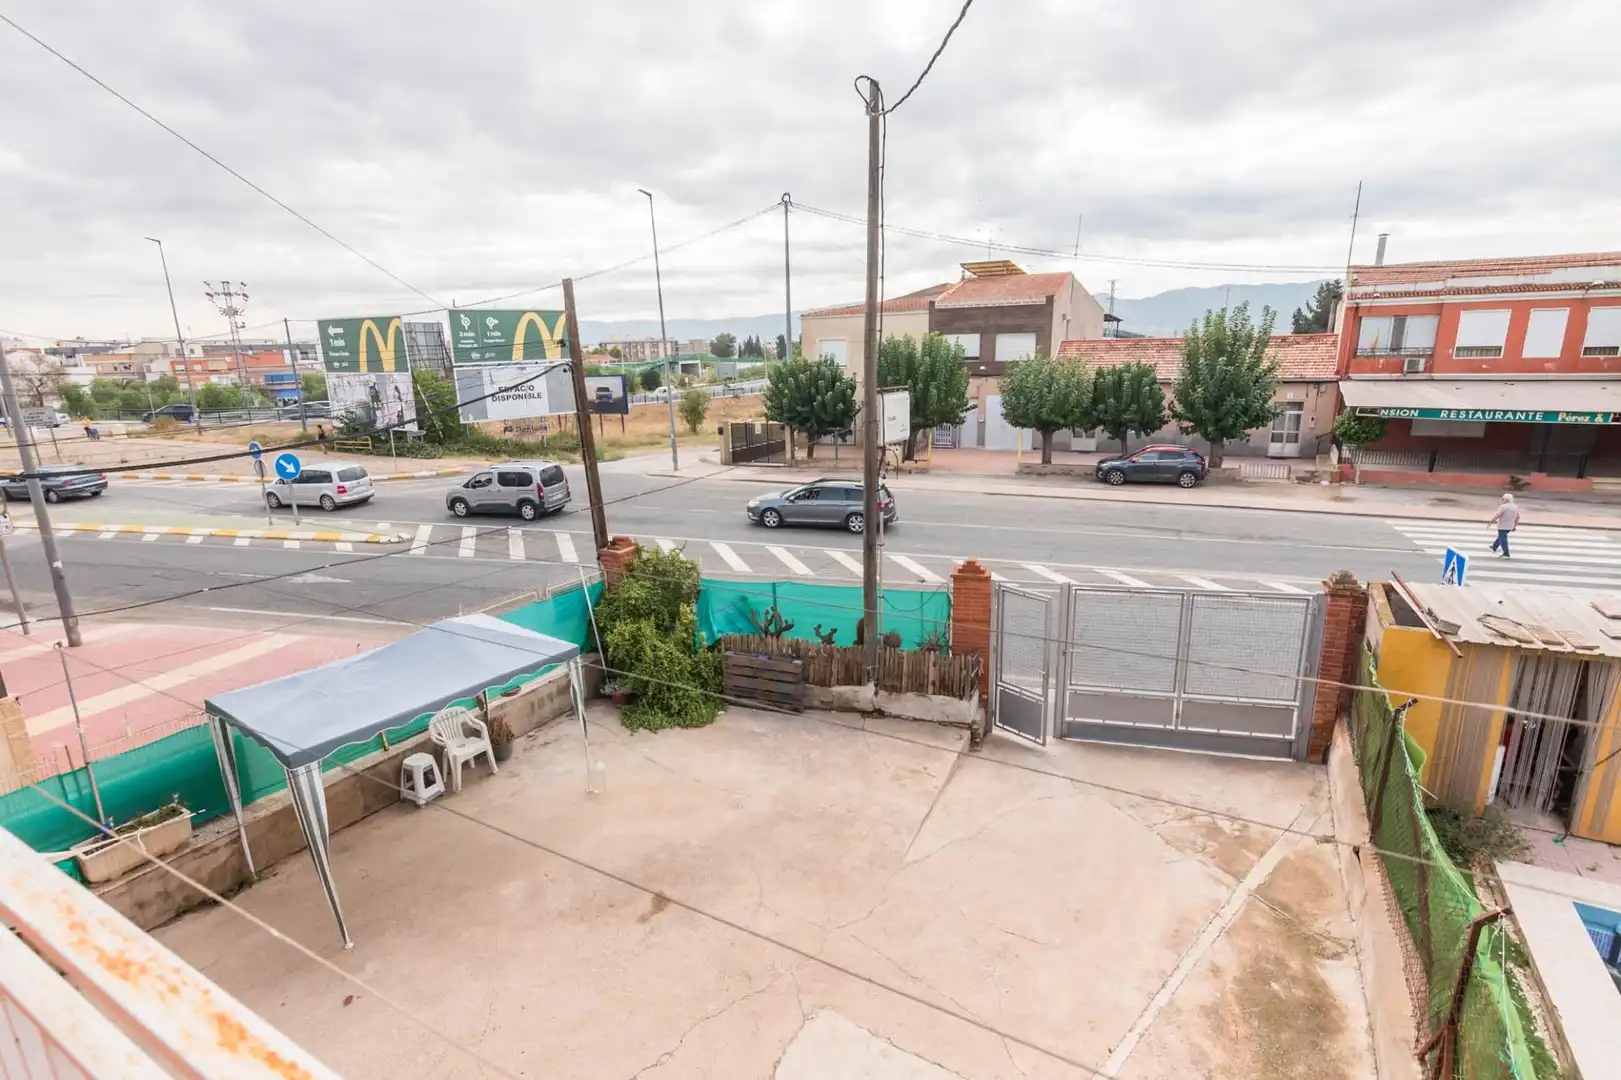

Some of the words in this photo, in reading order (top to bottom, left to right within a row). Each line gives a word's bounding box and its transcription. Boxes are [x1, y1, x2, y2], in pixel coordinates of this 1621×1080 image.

[491, 392, 542, 402] DISPONIBLE
[1440, 409, 1544, 421] RESTAURANTE
[1558, 412, 1590, 422] Pérez
